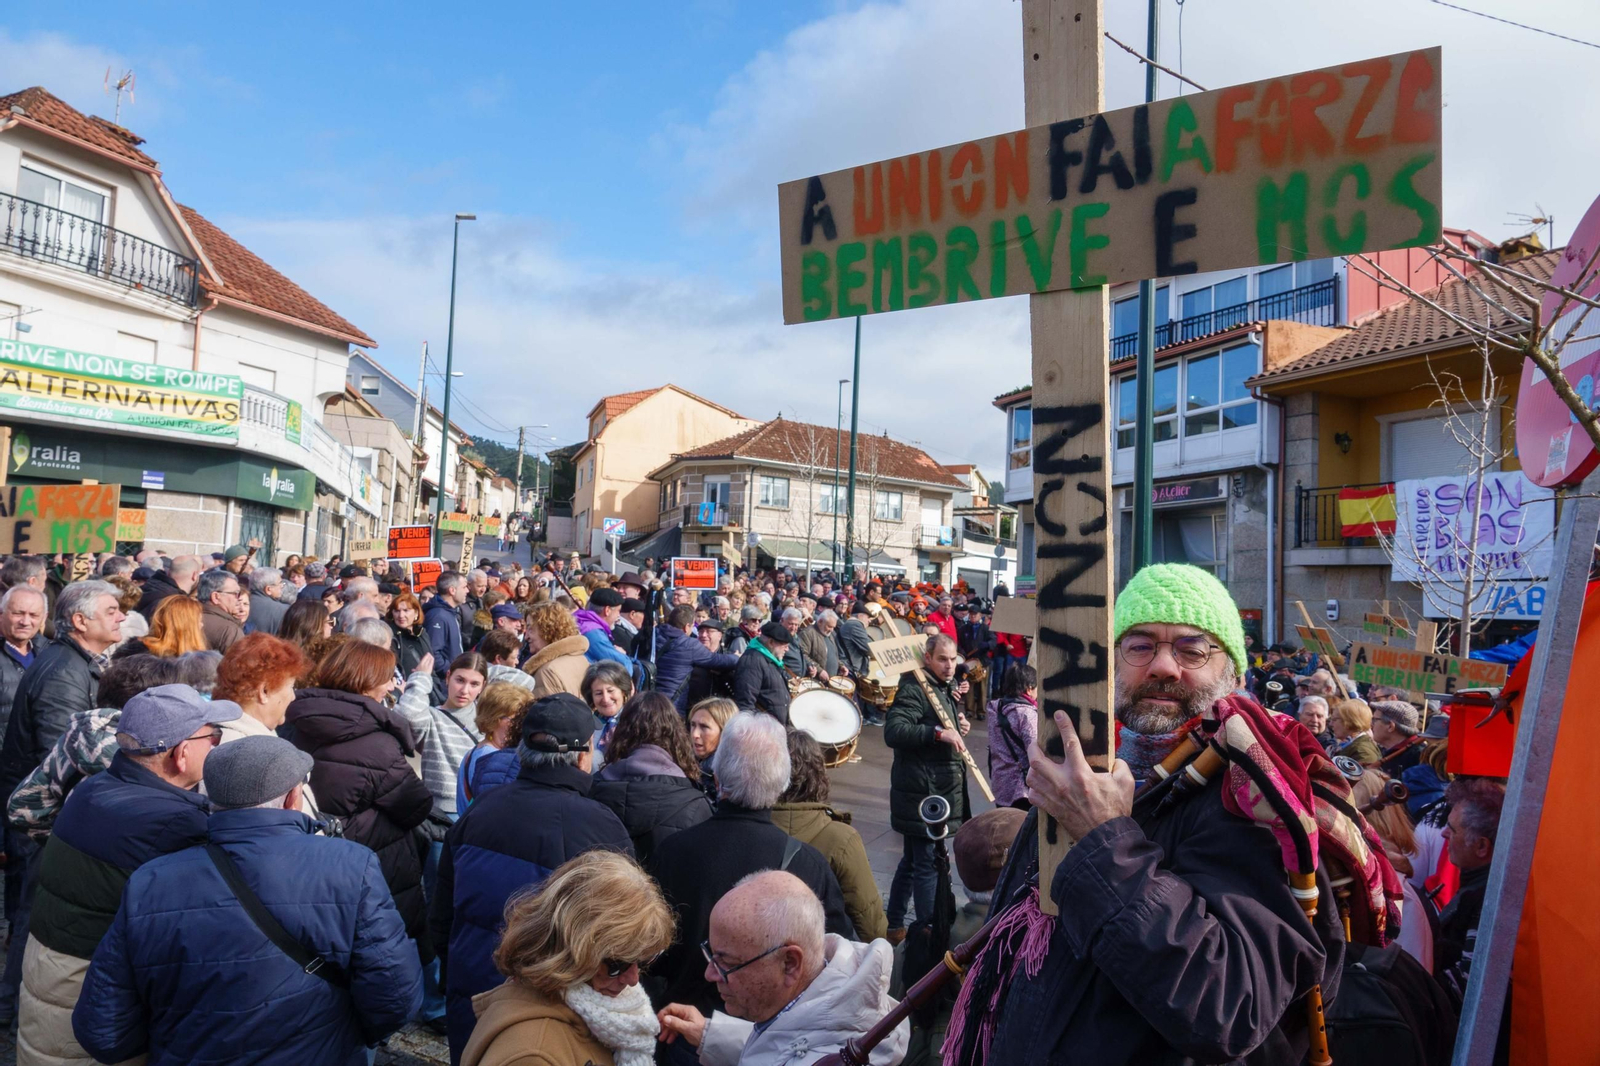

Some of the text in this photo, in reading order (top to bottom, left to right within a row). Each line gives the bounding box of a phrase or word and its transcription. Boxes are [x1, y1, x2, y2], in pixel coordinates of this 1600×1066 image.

[801, 51, 1436, 244] A UNION FAI A FORZA
[801, 153, 1438, 321] BEMBRIVE E MOS
[64, 352, 124, 377] NON
[130, 364, 158, 382] SE
[164, 368, 240, 395] ROMPE
[0, 368, 239, 421] ALTERNATIVAS
[16, 395, 76, 414] Bembrive
[31, 460, 80, 470] Agrotendas
[18, 487, 38, 518] A
[38, 486, 114, 519] FORZA
[1435, 477, 1522, 515] SAN
[13, 520, 113, 554] E MOS
[390, 527, 430, 539] SE VENDE
[1435, 510, 1526, 549] BLAS
[413, 561, 420, 573] SE
[674, 560, 714, 570] SE VENDE
[877, 645, 915, 667] LIBERAR
[1355, 647, 1367, 664] A
[1372, 649, 1421, 671] UNION
[1423, 655, 1448, 675] FAI
[1450, 659, 1460, 676] A
[1354, 663, 1457, 694] BEMBRIVE E
